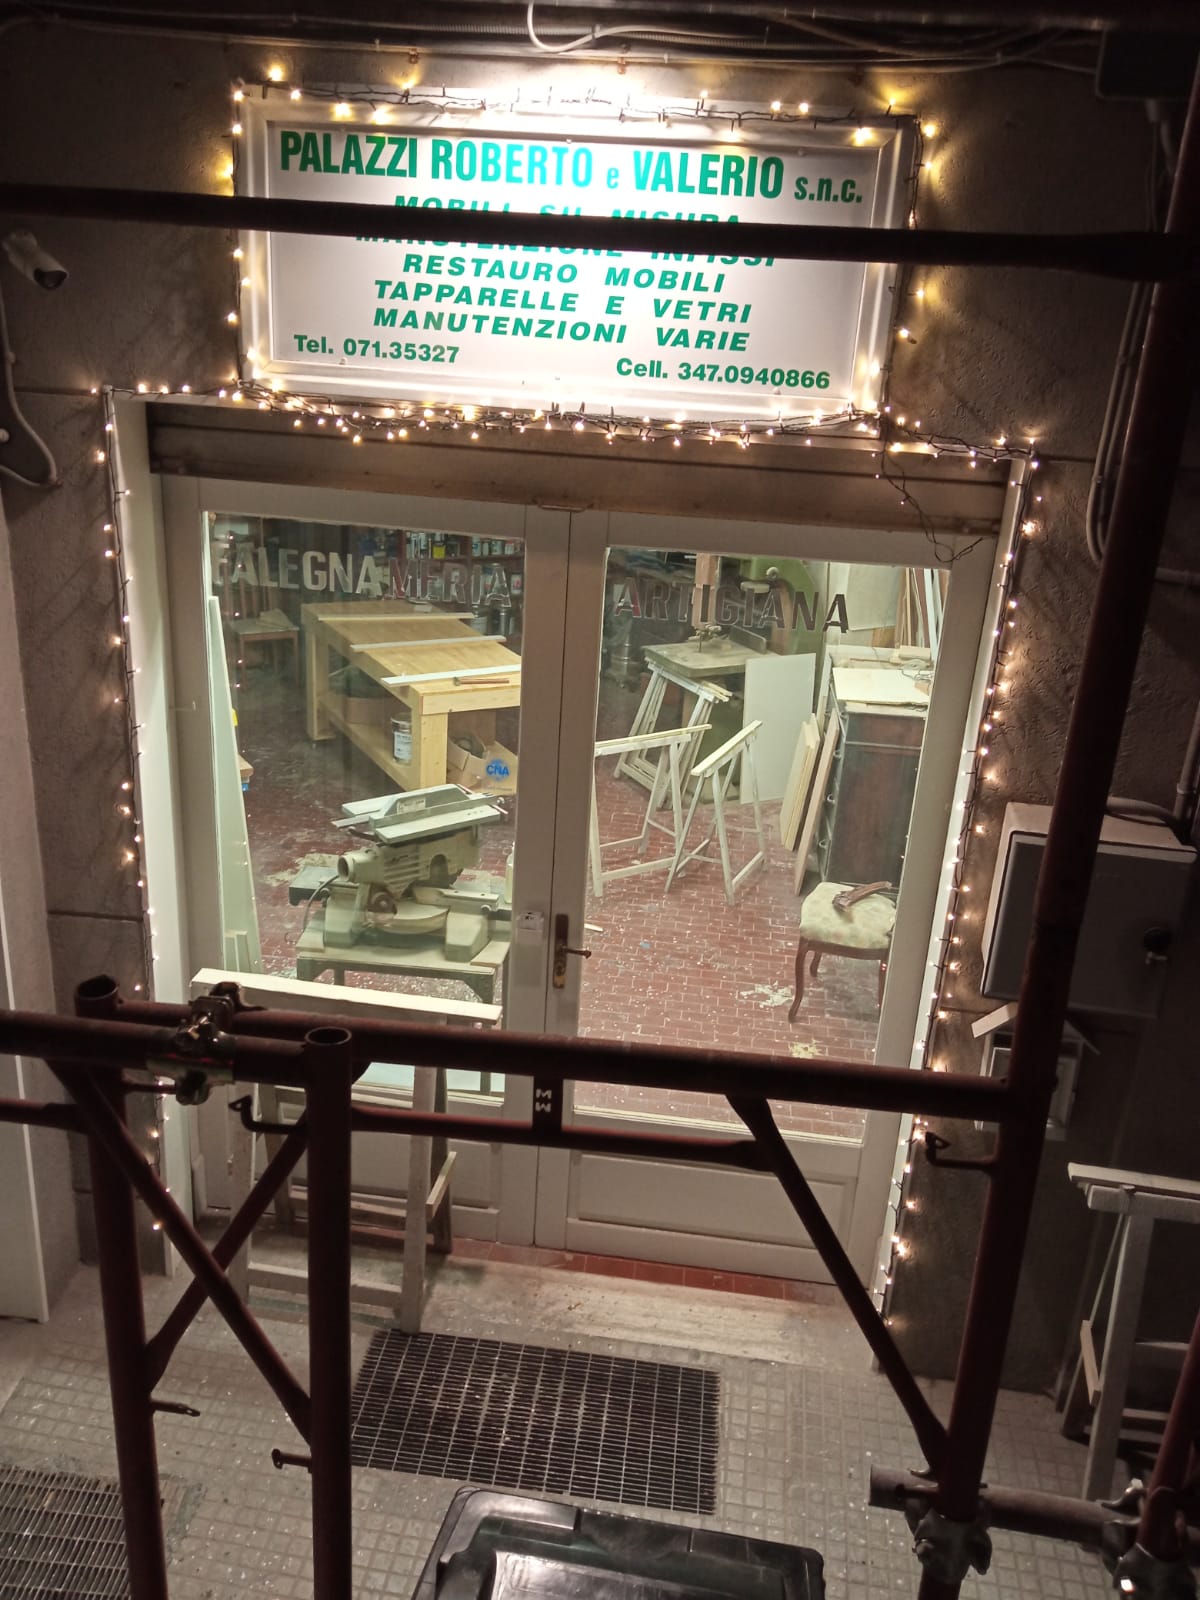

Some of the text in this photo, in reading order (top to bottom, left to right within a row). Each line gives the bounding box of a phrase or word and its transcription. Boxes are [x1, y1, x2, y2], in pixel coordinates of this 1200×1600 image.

[280, 131, 862, 203] PALAZZI ROBERTO e VALERIO s.n.c.
[403, 253, 726, 293] RESTAURO MOBILI
[375, 280, 752, 324] TAPPARELLE E VETRI
[294, 335, 460, 364] Tel. 071.35327
[374, 308, 751, 352] MANUTENZIONI VARIE
[616, 358, 830, 389] Cell. 347.0940866
[613, 576, 850, 634] ARTIGIANA
